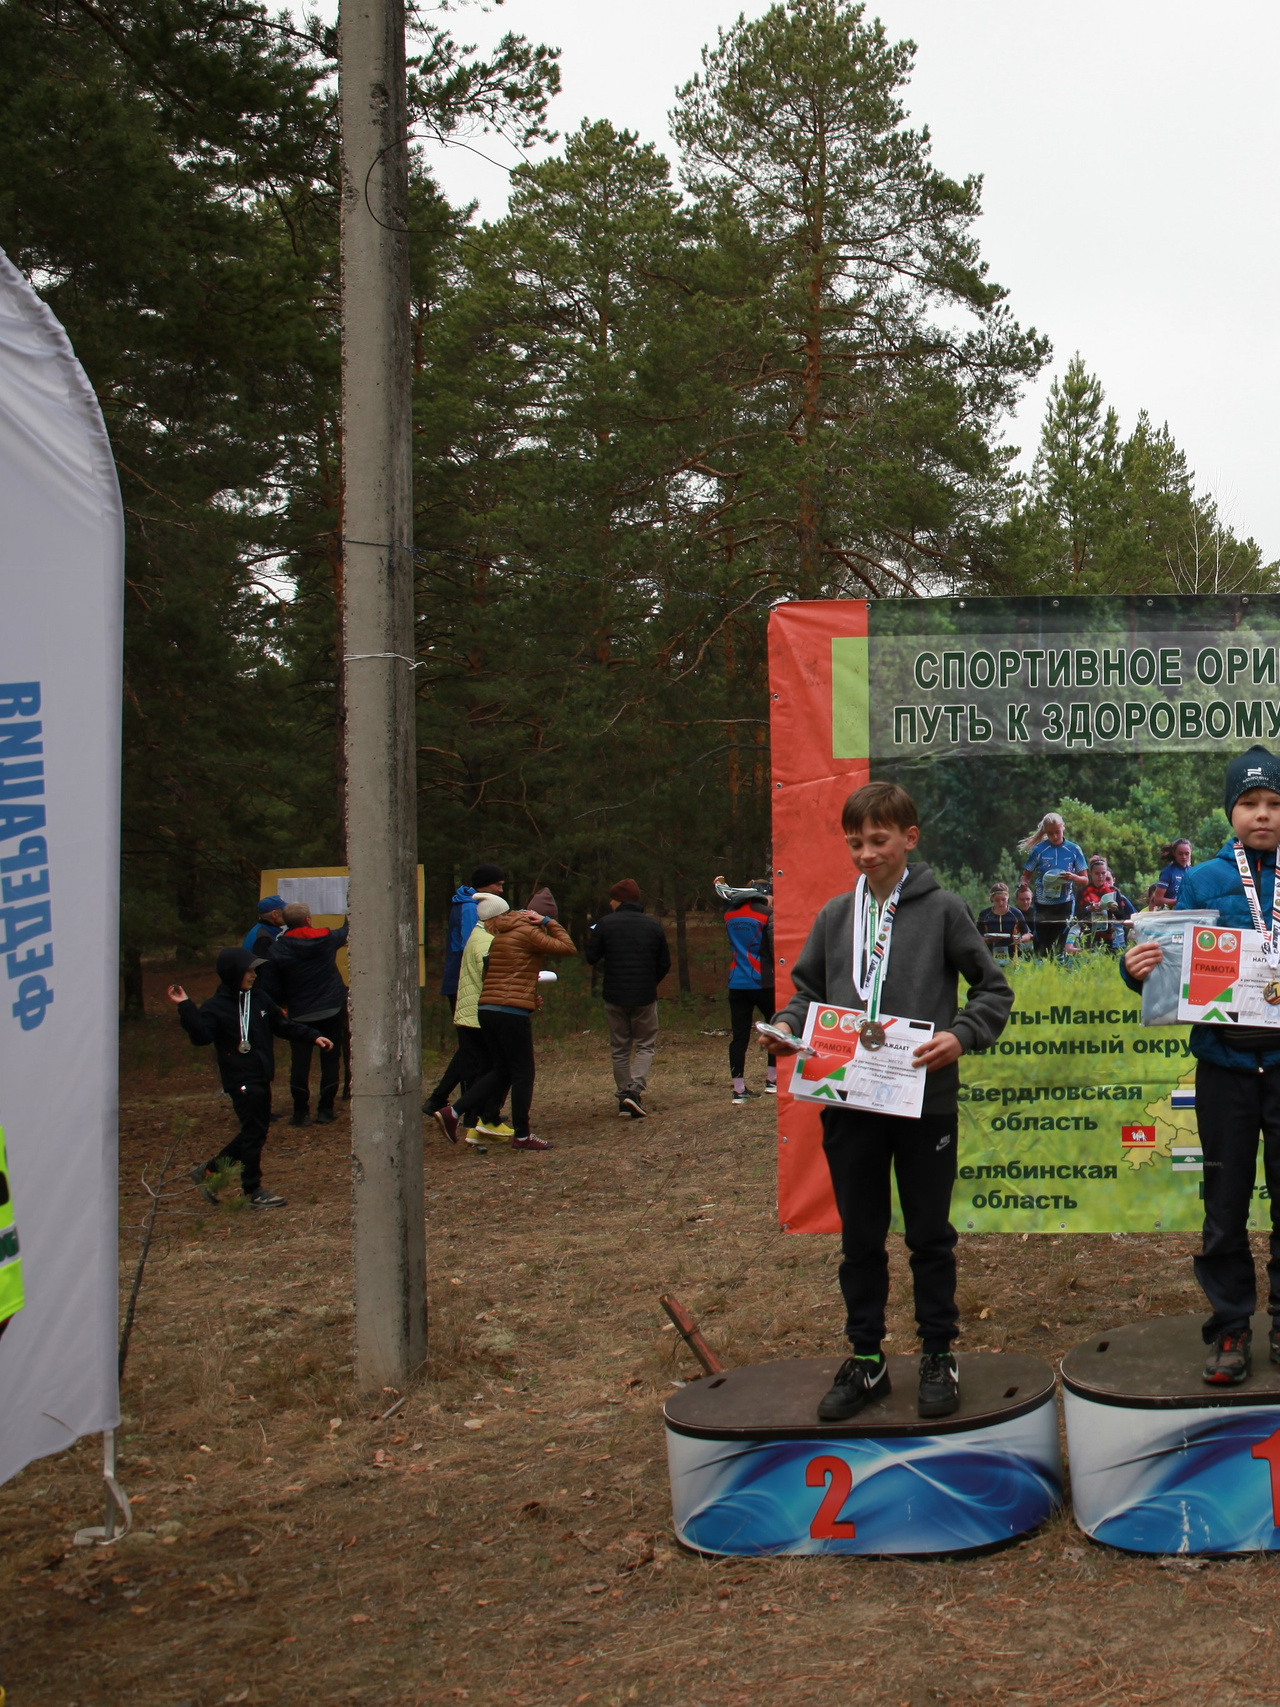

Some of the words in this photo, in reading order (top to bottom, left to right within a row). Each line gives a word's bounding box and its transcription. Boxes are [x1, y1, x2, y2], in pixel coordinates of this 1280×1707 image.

[913, 647, 1182, 690] СПОРТИВНОЕ
[893, 704, 993, 744] ПУТЬ
[1006, 703, 1030, 742] К
[1193, 963, 1236, 974] ГРАМОТА
[812, 1040, 853, 1054] ГРАМОТА
[1132, 1038, 1192, 1058] окру
[956, 1083, 1143, 1106] Свердловская
[990, 1111, 1099, 1132] область
[955, 1160, 1118, 1181] елябинская
[971, 1190, 1079, 1210] область
[806, 1456, 855, 1540] 2
